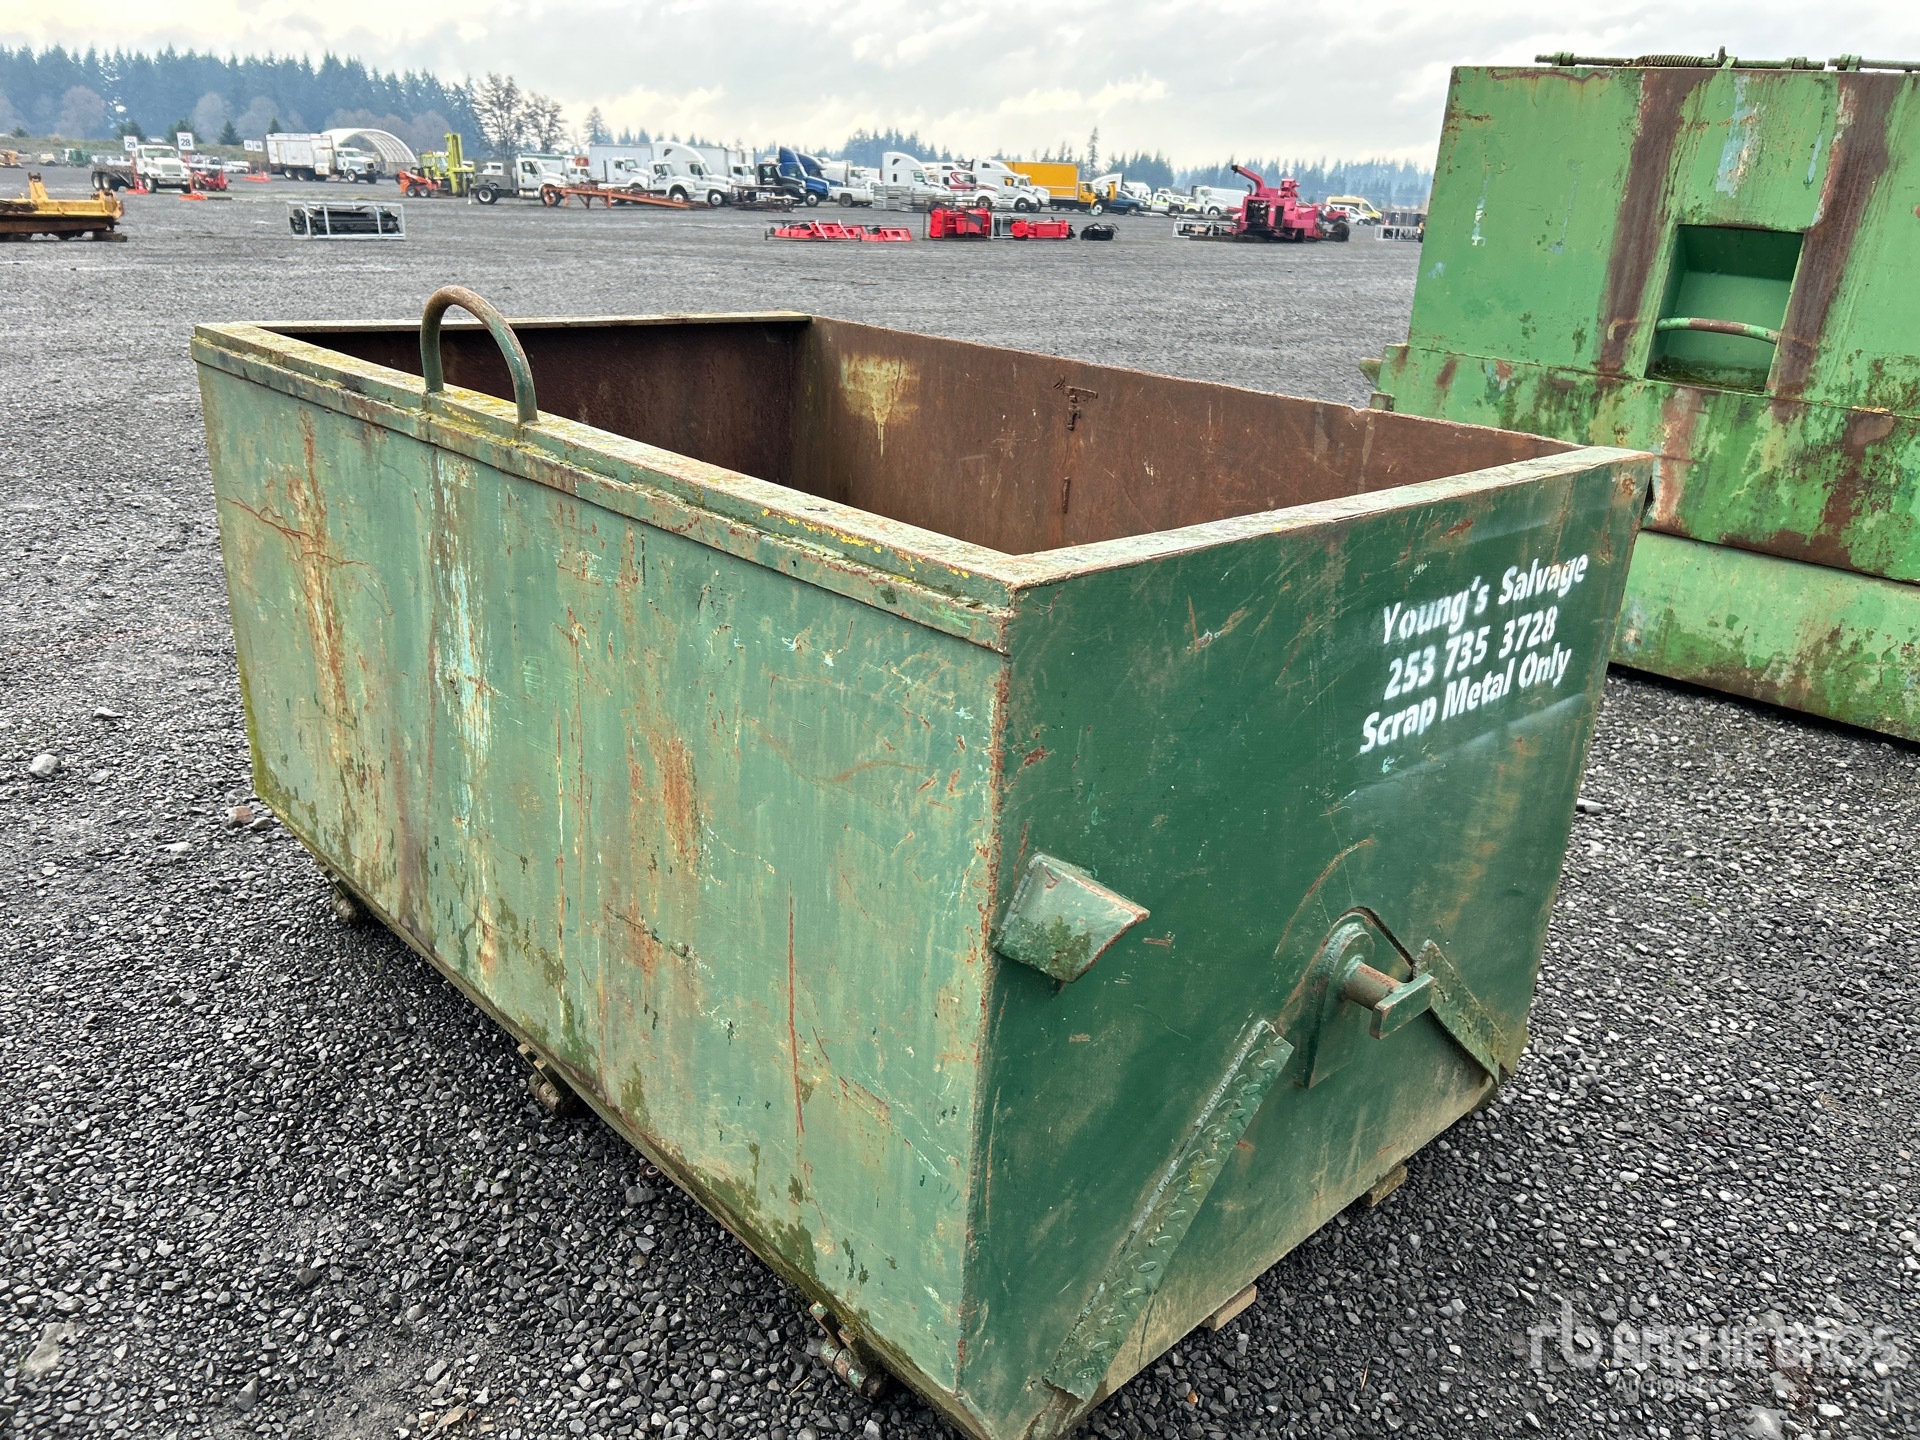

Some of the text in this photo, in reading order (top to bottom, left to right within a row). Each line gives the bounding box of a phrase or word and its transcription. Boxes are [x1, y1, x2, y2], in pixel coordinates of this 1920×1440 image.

[127, 141, 136, 149] 29
[180, 138, 191, 147] 28
[1382, 554, 1588, 644] Young's Salvage
[1383, 605, 1558, 700] 253 735 3728
[1359, 642, 1572, 754] Scrap Metal Only
